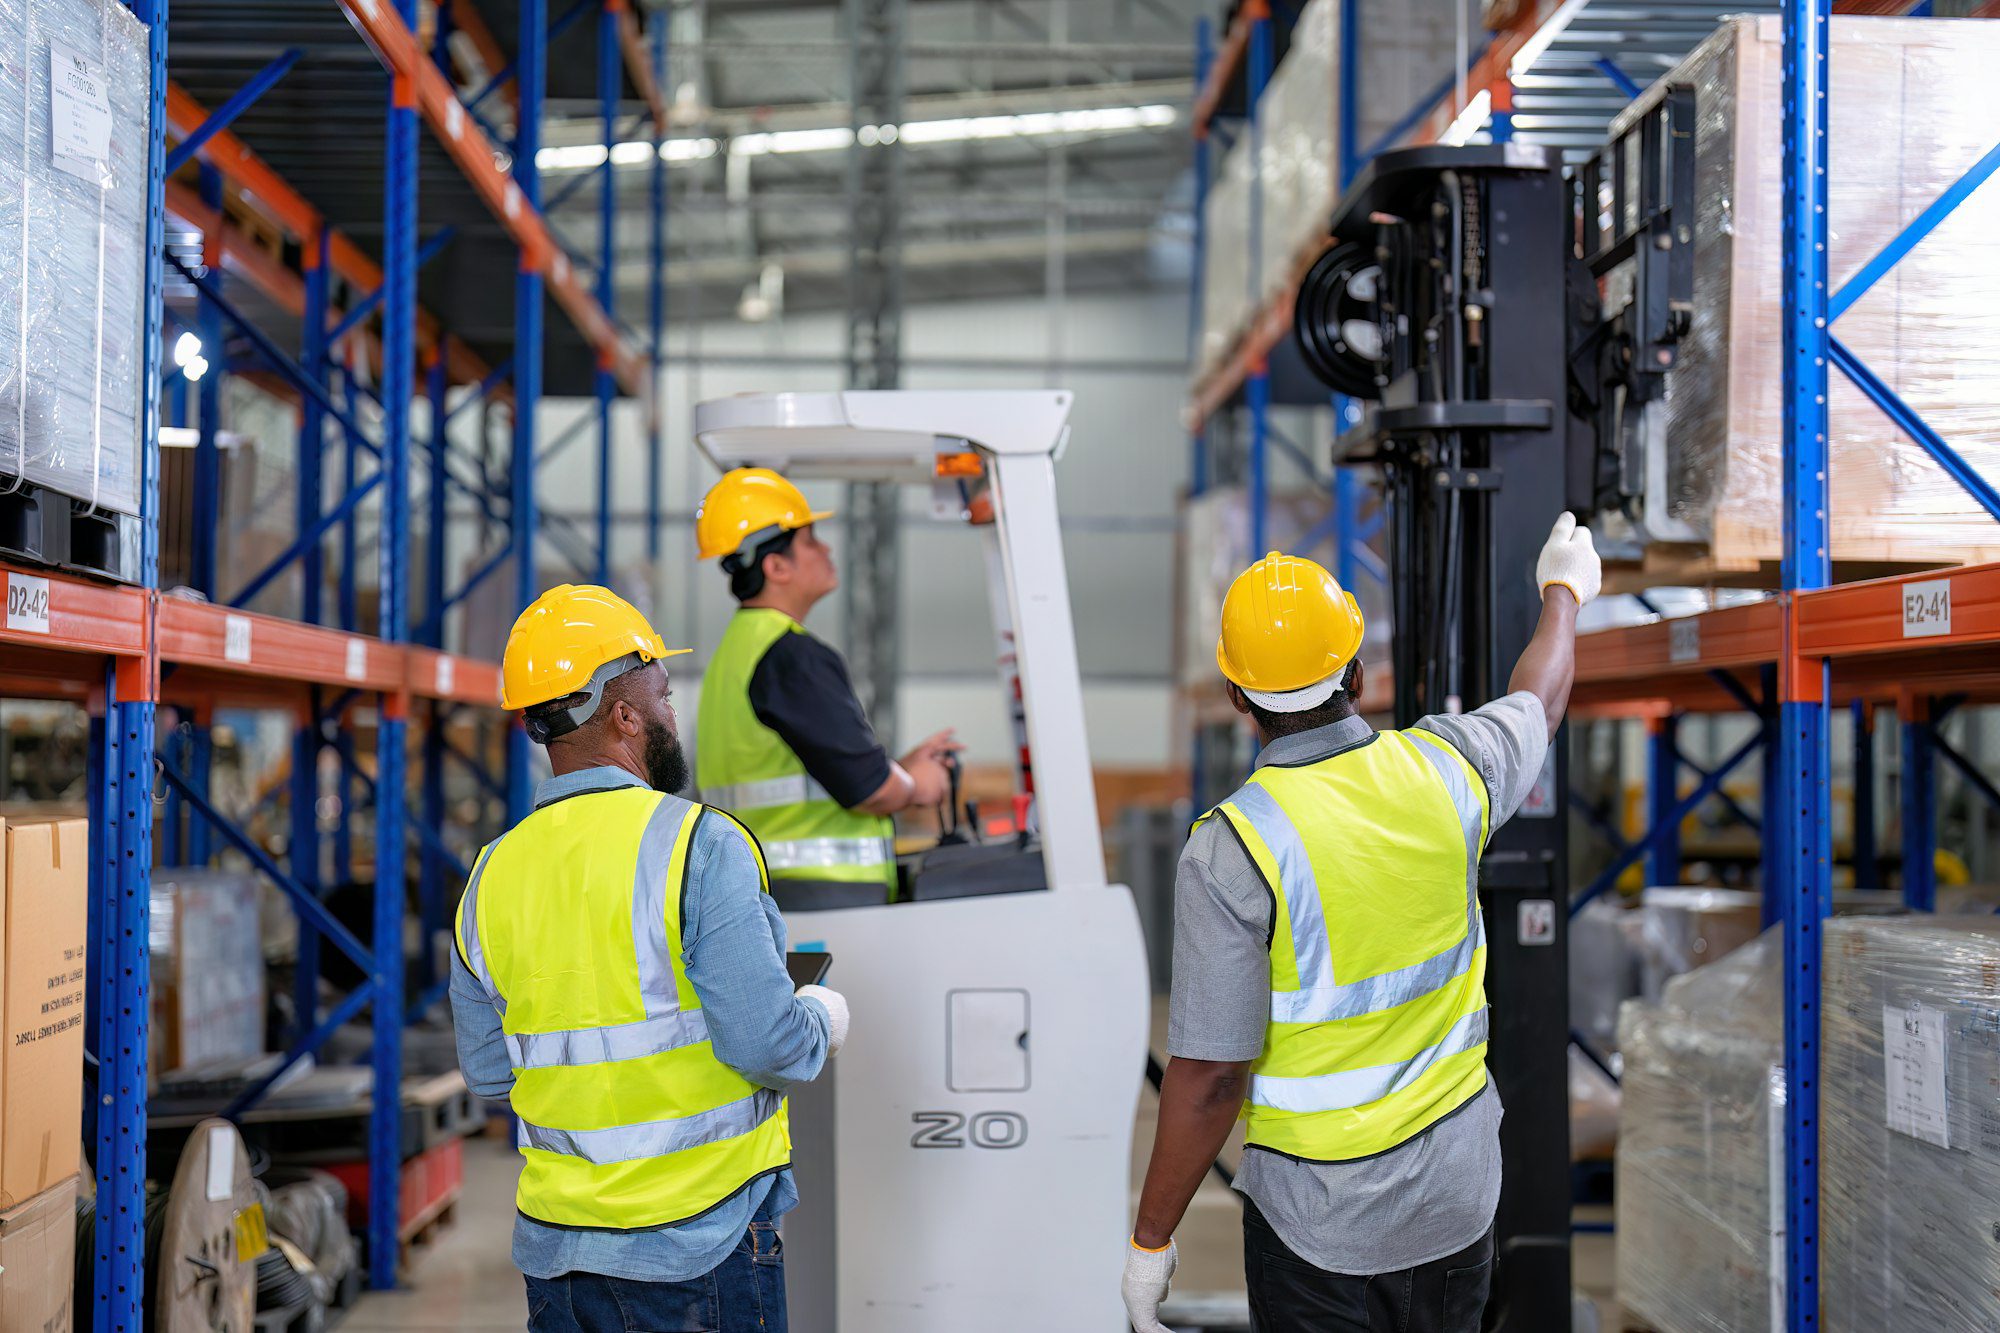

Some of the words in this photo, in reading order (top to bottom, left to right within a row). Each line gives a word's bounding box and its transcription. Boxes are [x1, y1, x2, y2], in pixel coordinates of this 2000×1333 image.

[9, 585, 48, 619] D2-42
[1905, 590, 1948, 623] E2-41
[910, 1111, 1029, 1149] 20
